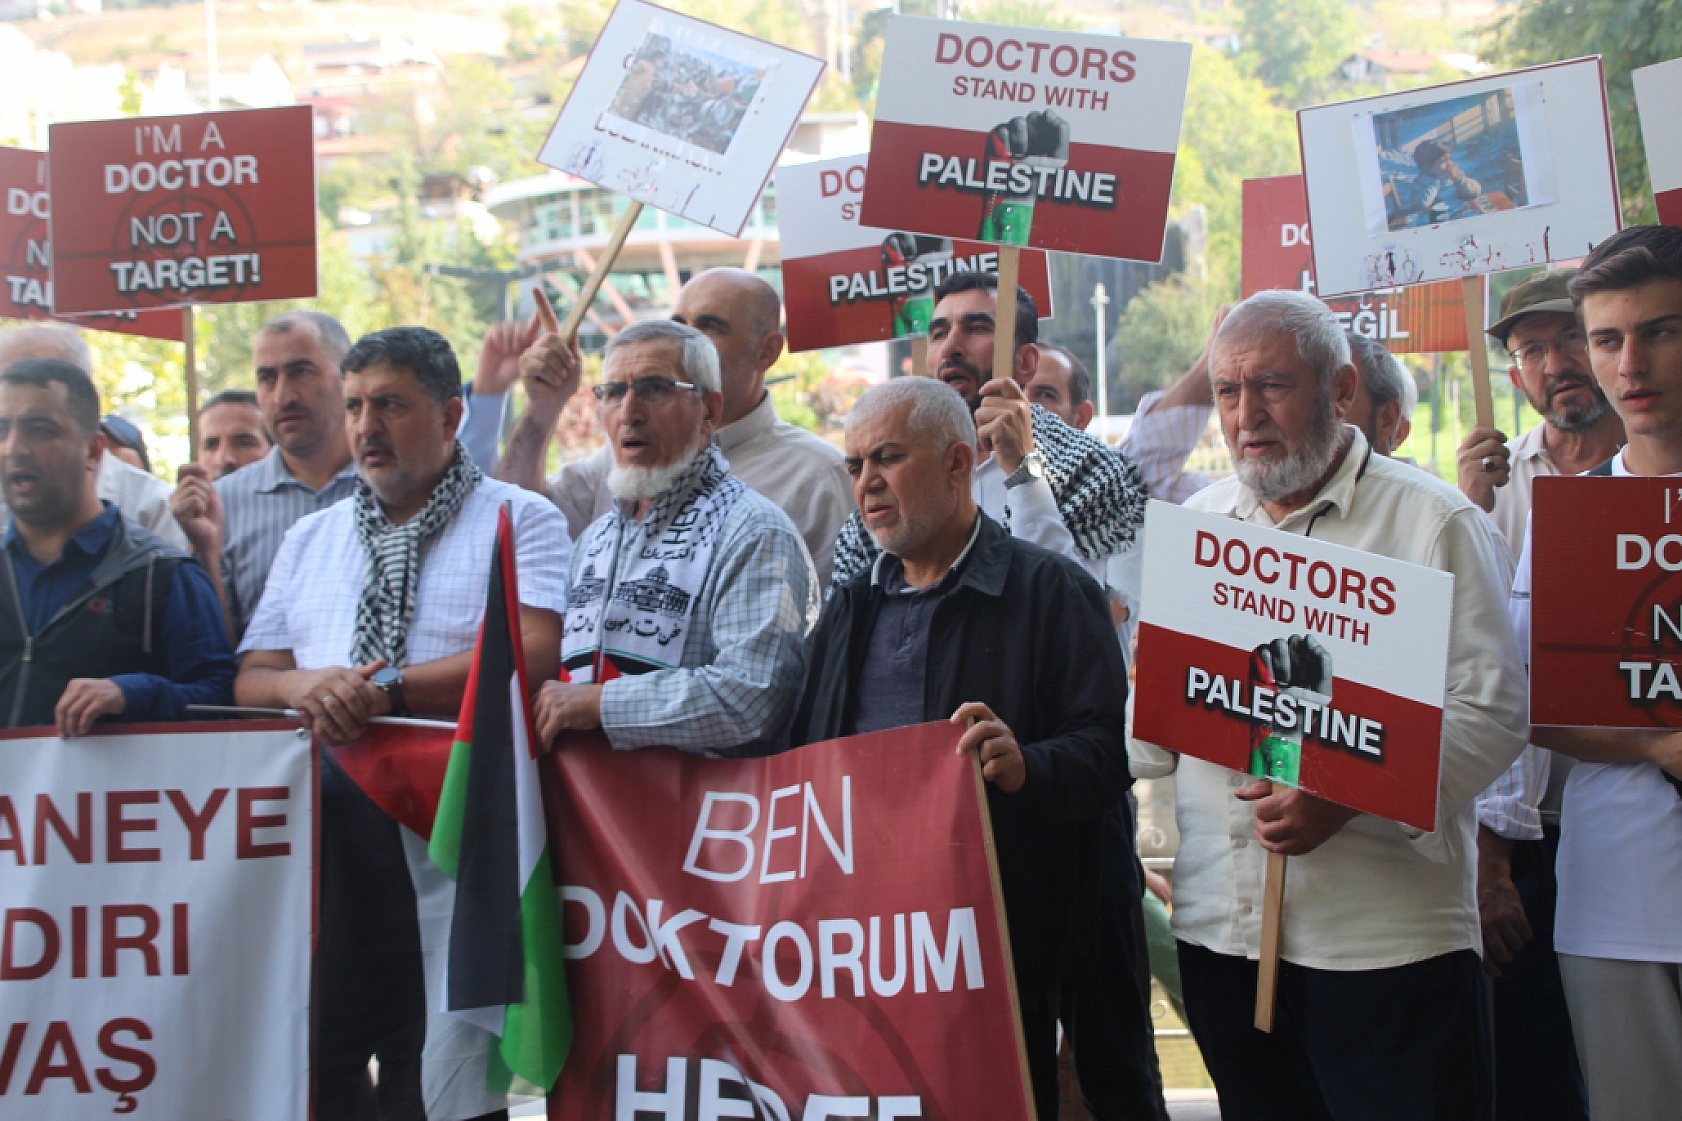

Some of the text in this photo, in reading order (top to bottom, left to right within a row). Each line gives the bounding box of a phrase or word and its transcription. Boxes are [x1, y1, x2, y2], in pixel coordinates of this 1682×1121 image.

[935, 32, 1137, 83] DOCTORS
[952, 76, 1109, 111] STAND WITH
[135, 121, 225, 155] I'M A
[104, 155, 258, 193] DOCTOR
[920, 152, 1116, 204] PALESTINE
[131, 211, 235, 245] NOT A
[110, 254, 260, 291] TARGET!
[829, 252, 998, 302] PALESTINE
[1194, 530, 1396, 616] DOCTORS
[1213, 582, 1369, 646] STAND WITH
[1187, 667, 1383, 757] PALESTINE
[682, 775, 854, 884] BEN
[0, 902, 190, 981] DIRI
[555, 885, 985, 1002] DOKTORUM
